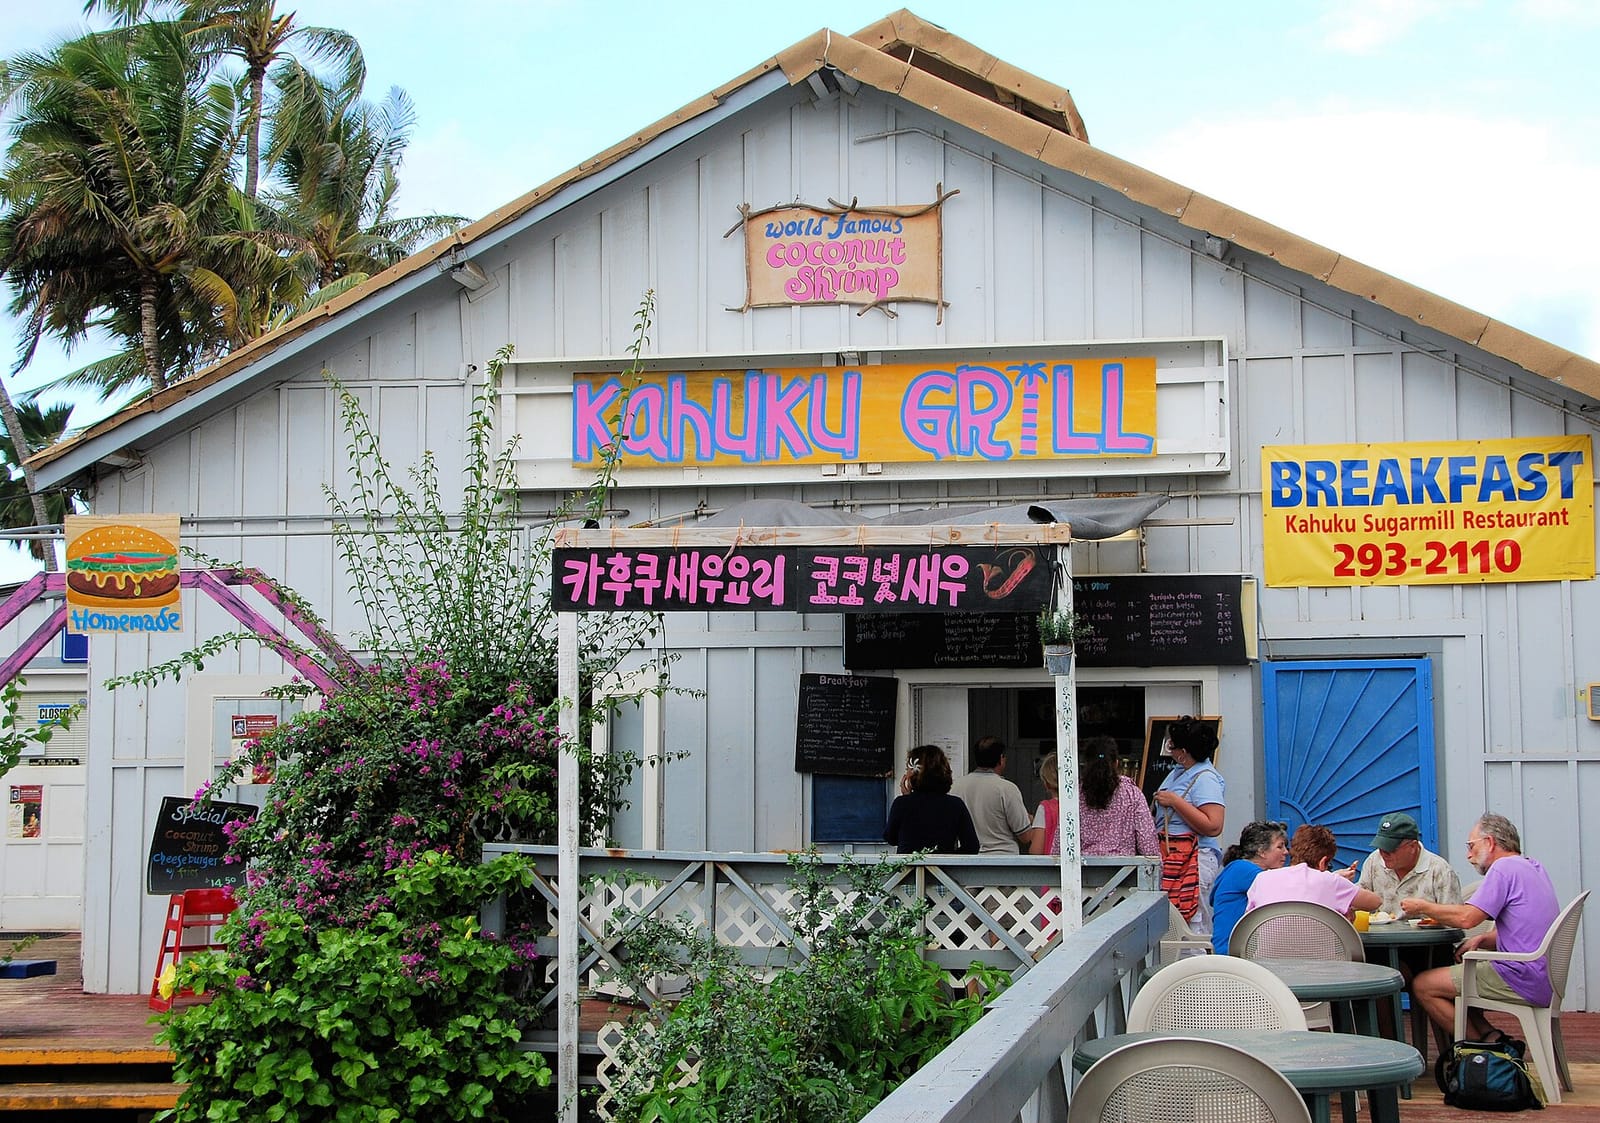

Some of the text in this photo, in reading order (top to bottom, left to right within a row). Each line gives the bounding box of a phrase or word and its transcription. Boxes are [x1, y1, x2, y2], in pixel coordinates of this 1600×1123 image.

[828, 213, 904, 240] famous
[766, 238, 907, 268] coconut
[784, 262, 899, 302] Shrimp
[900, 361, 1155, 461] GRILL
[1270, 451, 1585, 508] BREAKFAST
[1285, 507, 1569, 537] Kahuku Sugarmill Restaurant
[1333, 539, 1522, 577] 293-2110
[71, 607, 180, 632] Homemade
[819, 675, 868, 689] Breakfast
[171, 805, 228, 825] Special
